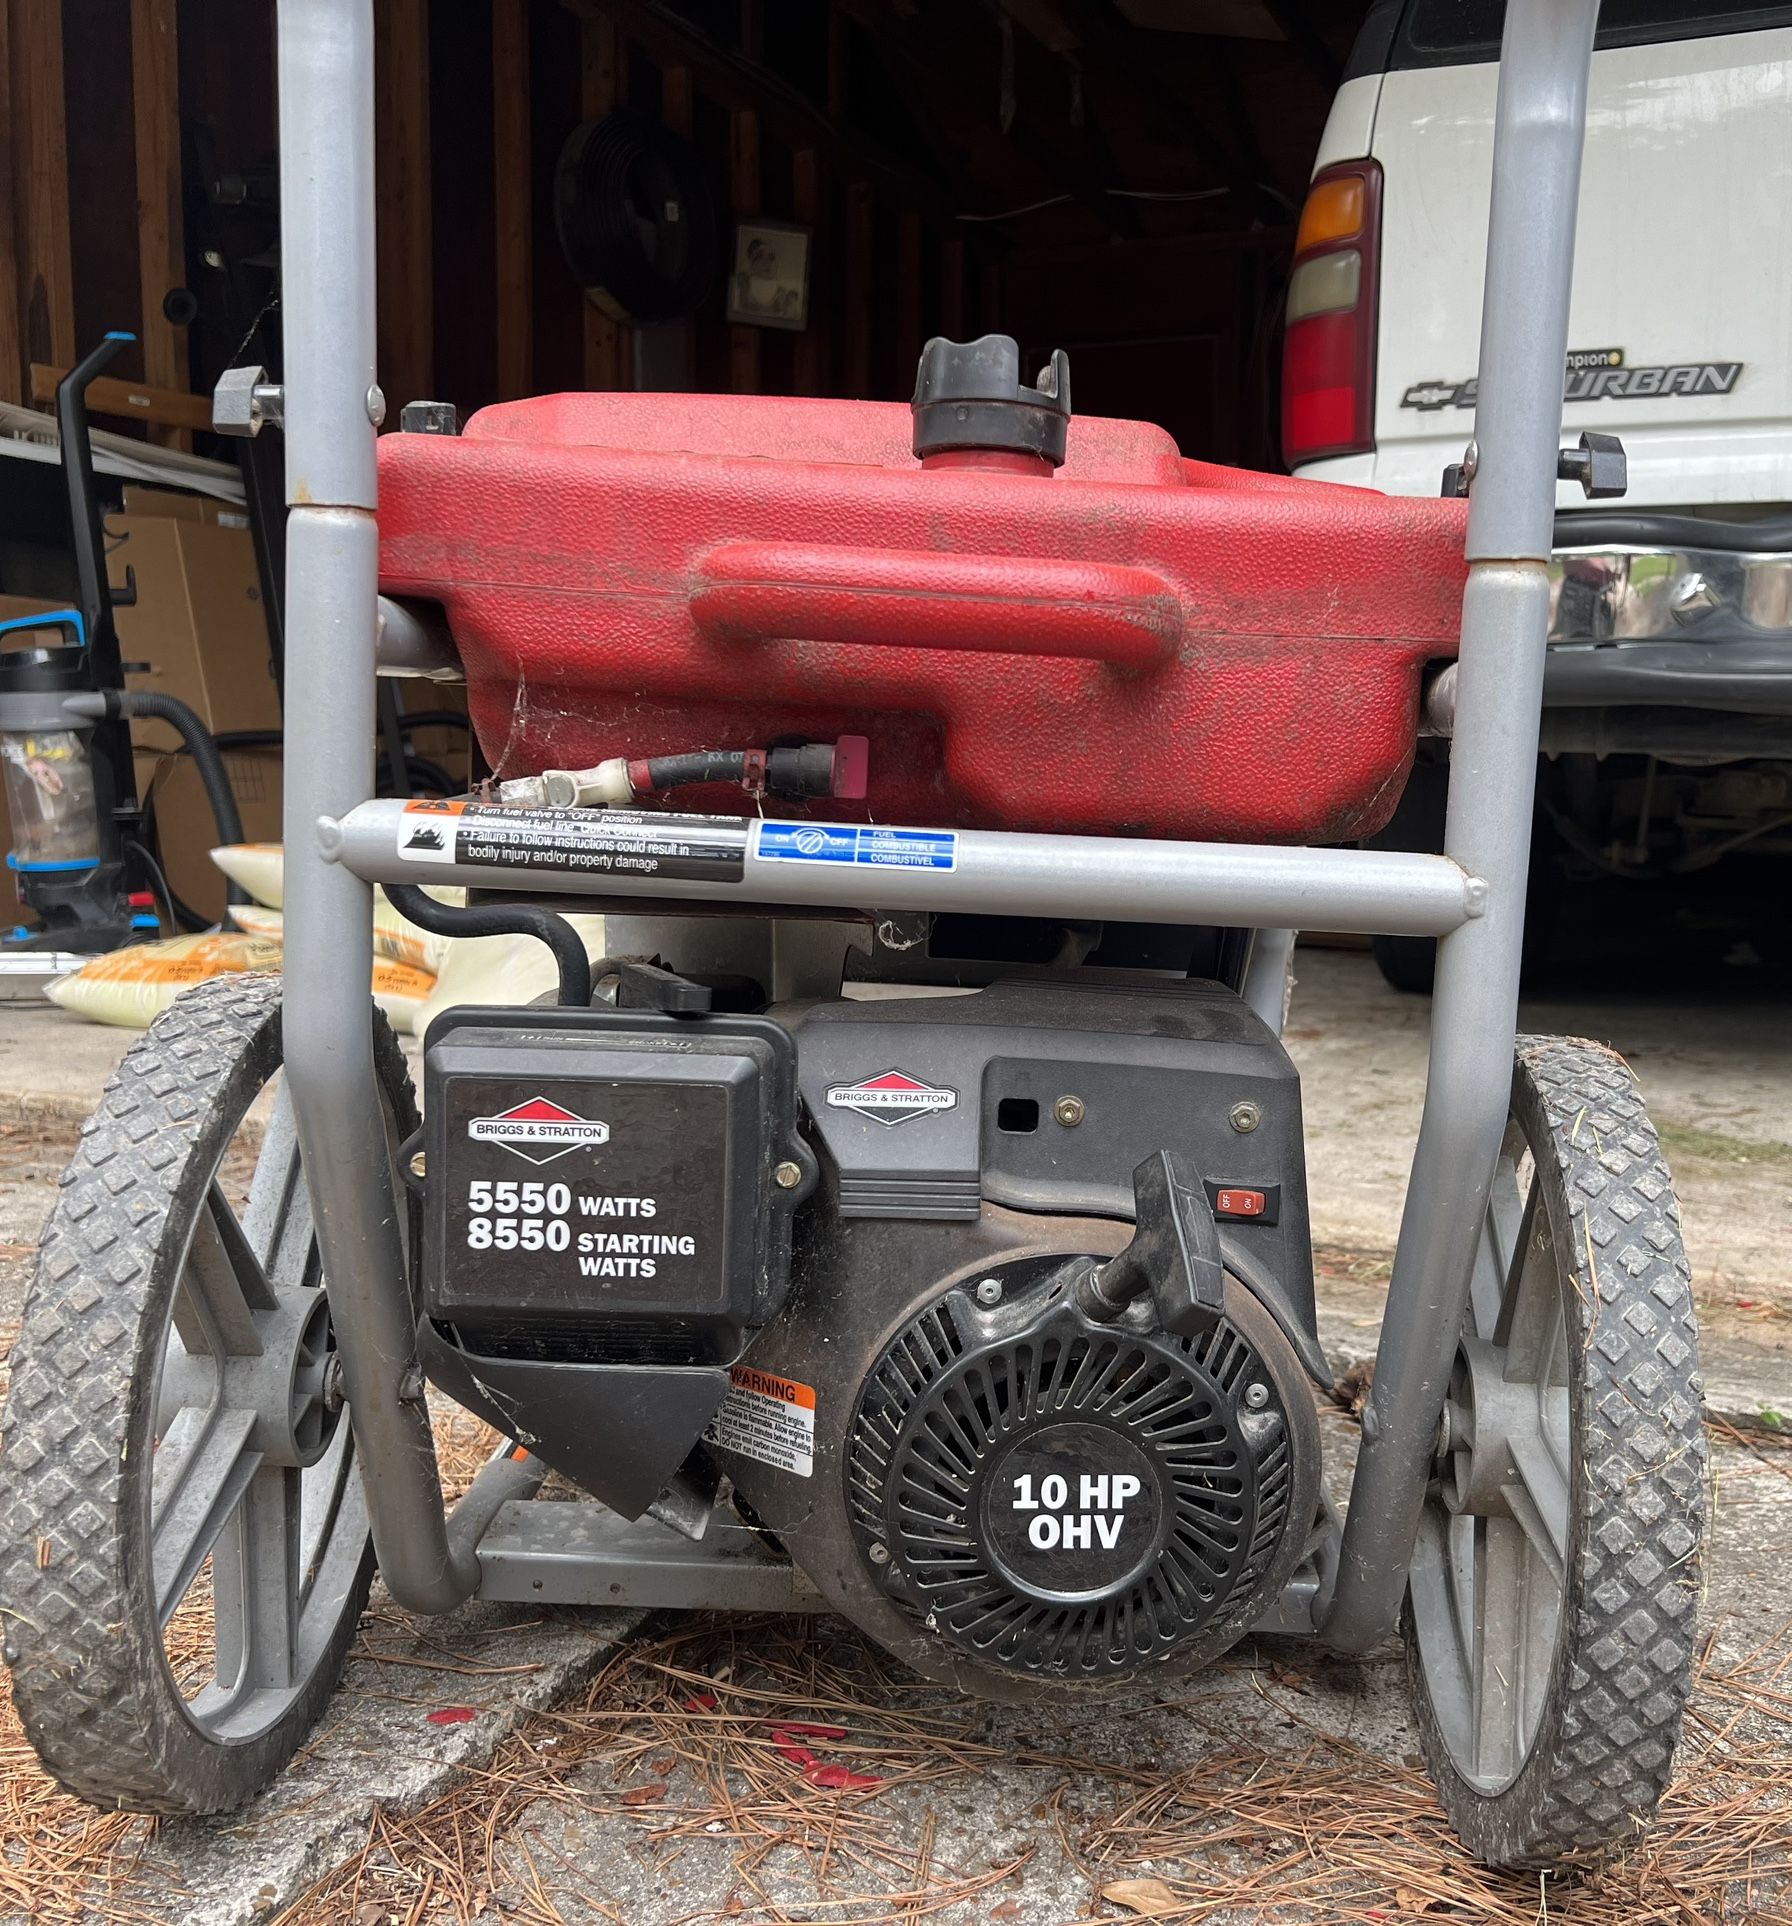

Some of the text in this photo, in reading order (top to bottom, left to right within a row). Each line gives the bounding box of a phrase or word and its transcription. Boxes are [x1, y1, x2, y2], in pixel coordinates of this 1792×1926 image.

[1566, 354, 1608, 370] mpion
[478, 806, 500, 815] Turn
[502, 808, 522, 816] fuel
[526, 810, 552, 818] valve
[555, 811, 565, 819] to
[602, 814, 642, 824] position
[471, 831, 689, 856] Failure to follow instructions could result in
[872, 841, 936, 852] COMBUSTIBLE
[468, 844, 658, 872] bodily injury and/or property damage
[835, 1093, 948, 1102] BRIGGS & STRATTON
[476, 1124, 602, 1138] BRIGGS & STRATTON
[468, 1180, 656, 1218] 5550 WATTS
[1222, 1194, 1230, 1208] OFF
[1245, 1198, 1251, 1209] ON
[468, 1217, 695, 1256] 8550 STARTING
[578, 1257, 656, 1278] WATTS
[730, 1368, 796, 1402] WARNING
[752, 1403, 767, 1415] before
[768, 1410, 786, 1424] running
[762, 1396, 785, 1413] Operating
[723, 1428, 741, 1441] Engines
[753, 1440, 770, 1451] carbon
[751, 1424, 753, 1432] 2
[754, 1427, 772, 1439] minutes
[774, 1432, 788, 1445] before
[775, 1423, 787, 1434] Allow
[789, 1429, 804, 1440] engine
[722, 1437, 730, 1446] DO
[731, 1440, 742, 1450] NOT
[743, 1446, 751, 1454] run
[758, 1451, 781, 1465] enclosed
[1013, 1474, 1140, 1509] 10 HP
[1028, 1514, 1124, 1549] OHV
